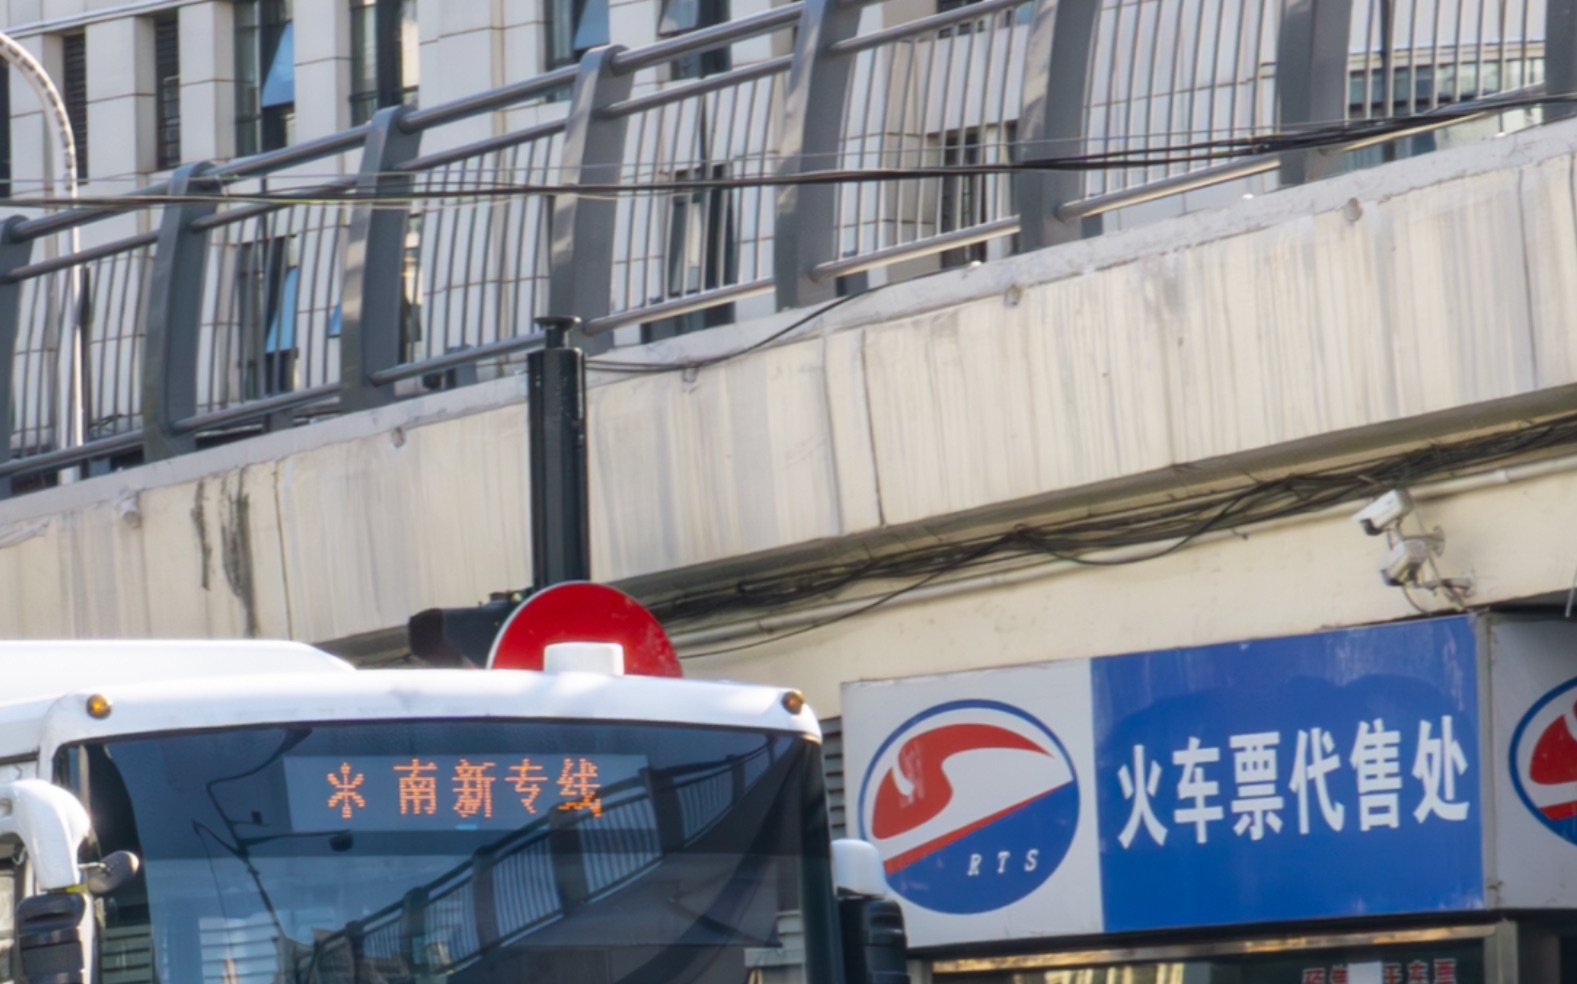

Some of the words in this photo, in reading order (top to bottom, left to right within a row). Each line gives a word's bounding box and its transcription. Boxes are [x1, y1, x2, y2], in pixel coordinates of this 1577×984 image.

[393, 758, 602, 818] 南新专线
[1117, 715, 1470, 849] 火车票代售处
[967, 848, 1039, 876] RTS
